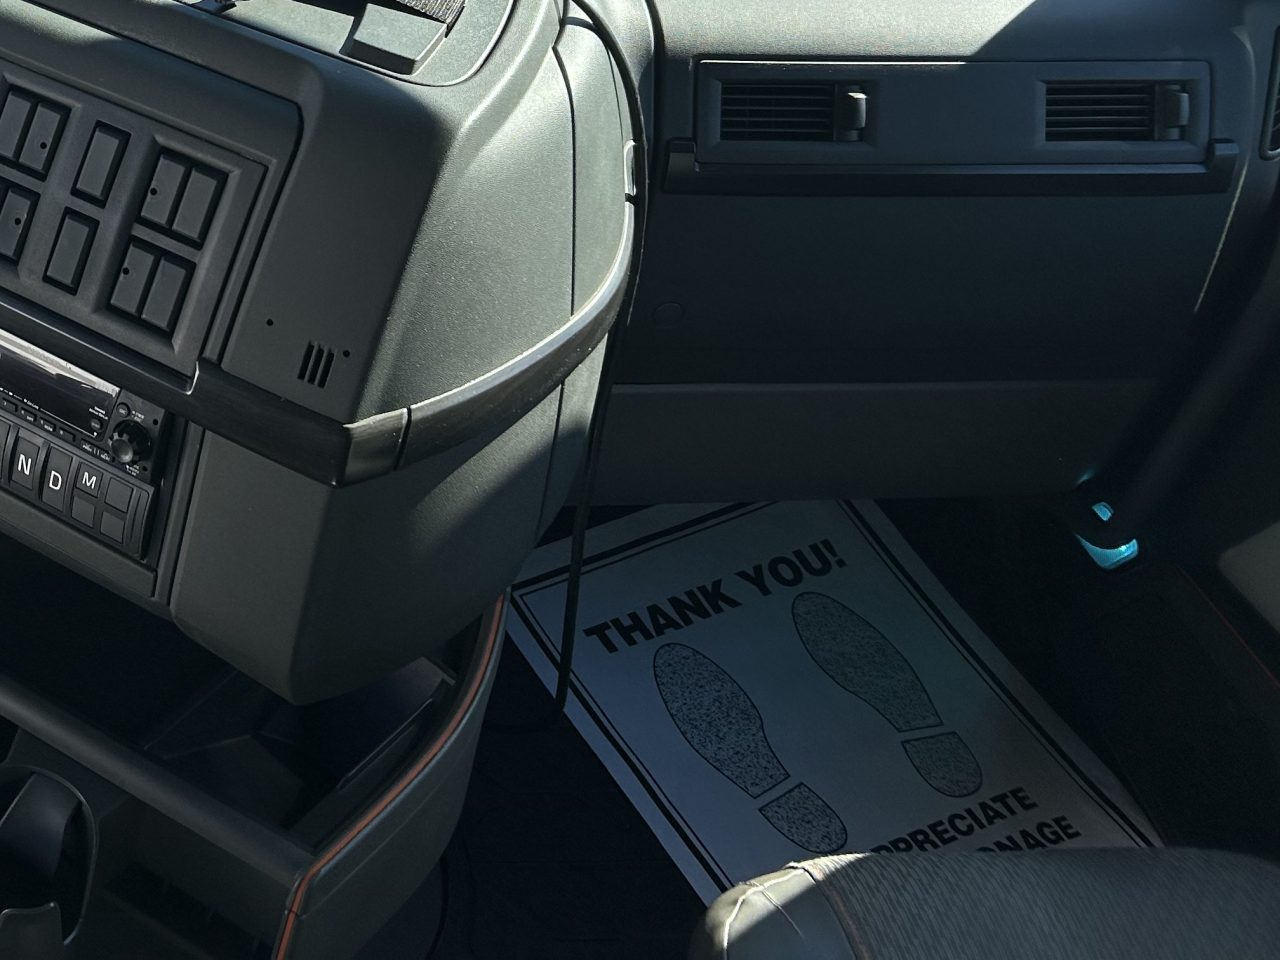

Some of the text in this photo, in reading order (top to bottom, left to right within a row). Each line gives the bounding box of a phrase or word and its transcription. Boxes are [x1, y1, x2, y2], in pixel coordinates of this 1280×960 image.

[17, 453, 32, 476] N
[49, 471, 62, 491] D
[81, 470, 97, 490] M
[583, 539, 849, 654] THANK YOU!
[870, 787, 1039, 854] PRECIATE
